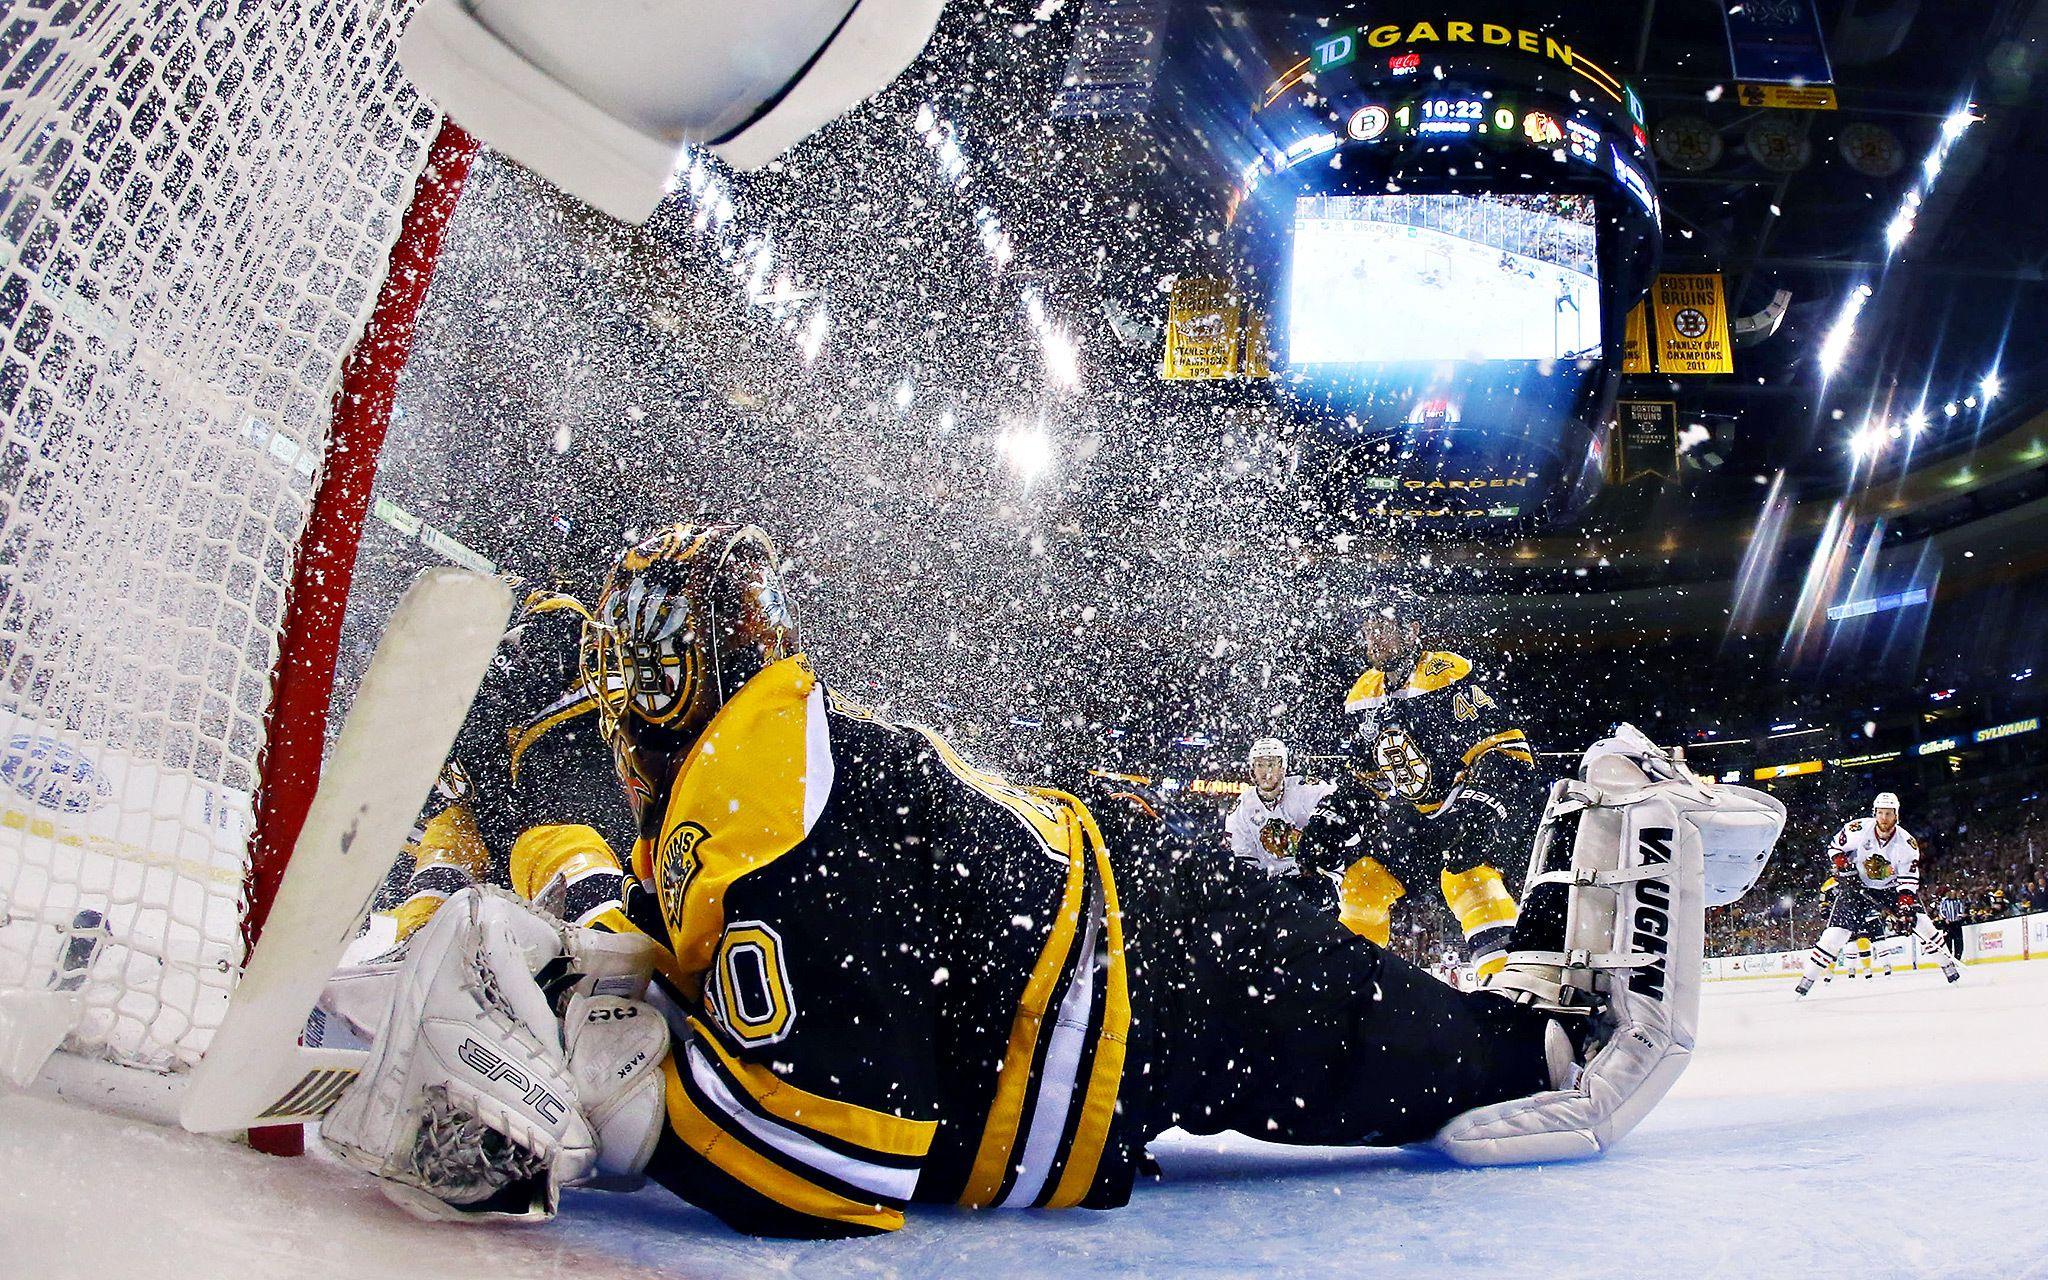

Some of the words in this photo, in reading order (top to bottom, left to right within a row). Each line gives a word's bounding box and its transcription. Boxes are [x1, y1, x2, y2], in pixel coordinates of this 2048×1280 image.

[1315, 36, 1351, 65] TD
[1367, 22, 1573, 66] GARDEN
[1394, 106, 1410, 127] 1
[1421, 100, 1483, 119] 10:22
[1494, 108, 1514, 130] 0
[1661, 278, 1714, 291] BOSTON
[1662, 292, 1715, 305] BRUINS
[1667, 341, 1702, 350] STANLEY
[1704, 341, 1720, 350] CUP
[1667, 351, 1723, 361] CHAMPIONS
[1687, 362, 1707, 371] 2011
[1631, 404, 1662, 412] BOSTON
[1631, 412, 1662, 420] BRUINS
[1403, 477, 1527, 489] GARDEN
[1453, 684, 1498, 722] 44
[1977, 718, 2038, 742] SYLVANIA
[1628, 827, 1674, 1002] VAUGHN
[705, 920, 797, 1049] 0
[617, 1051, 646, 1079] RASK
[458, 1037, 566, 1125] EPIC
